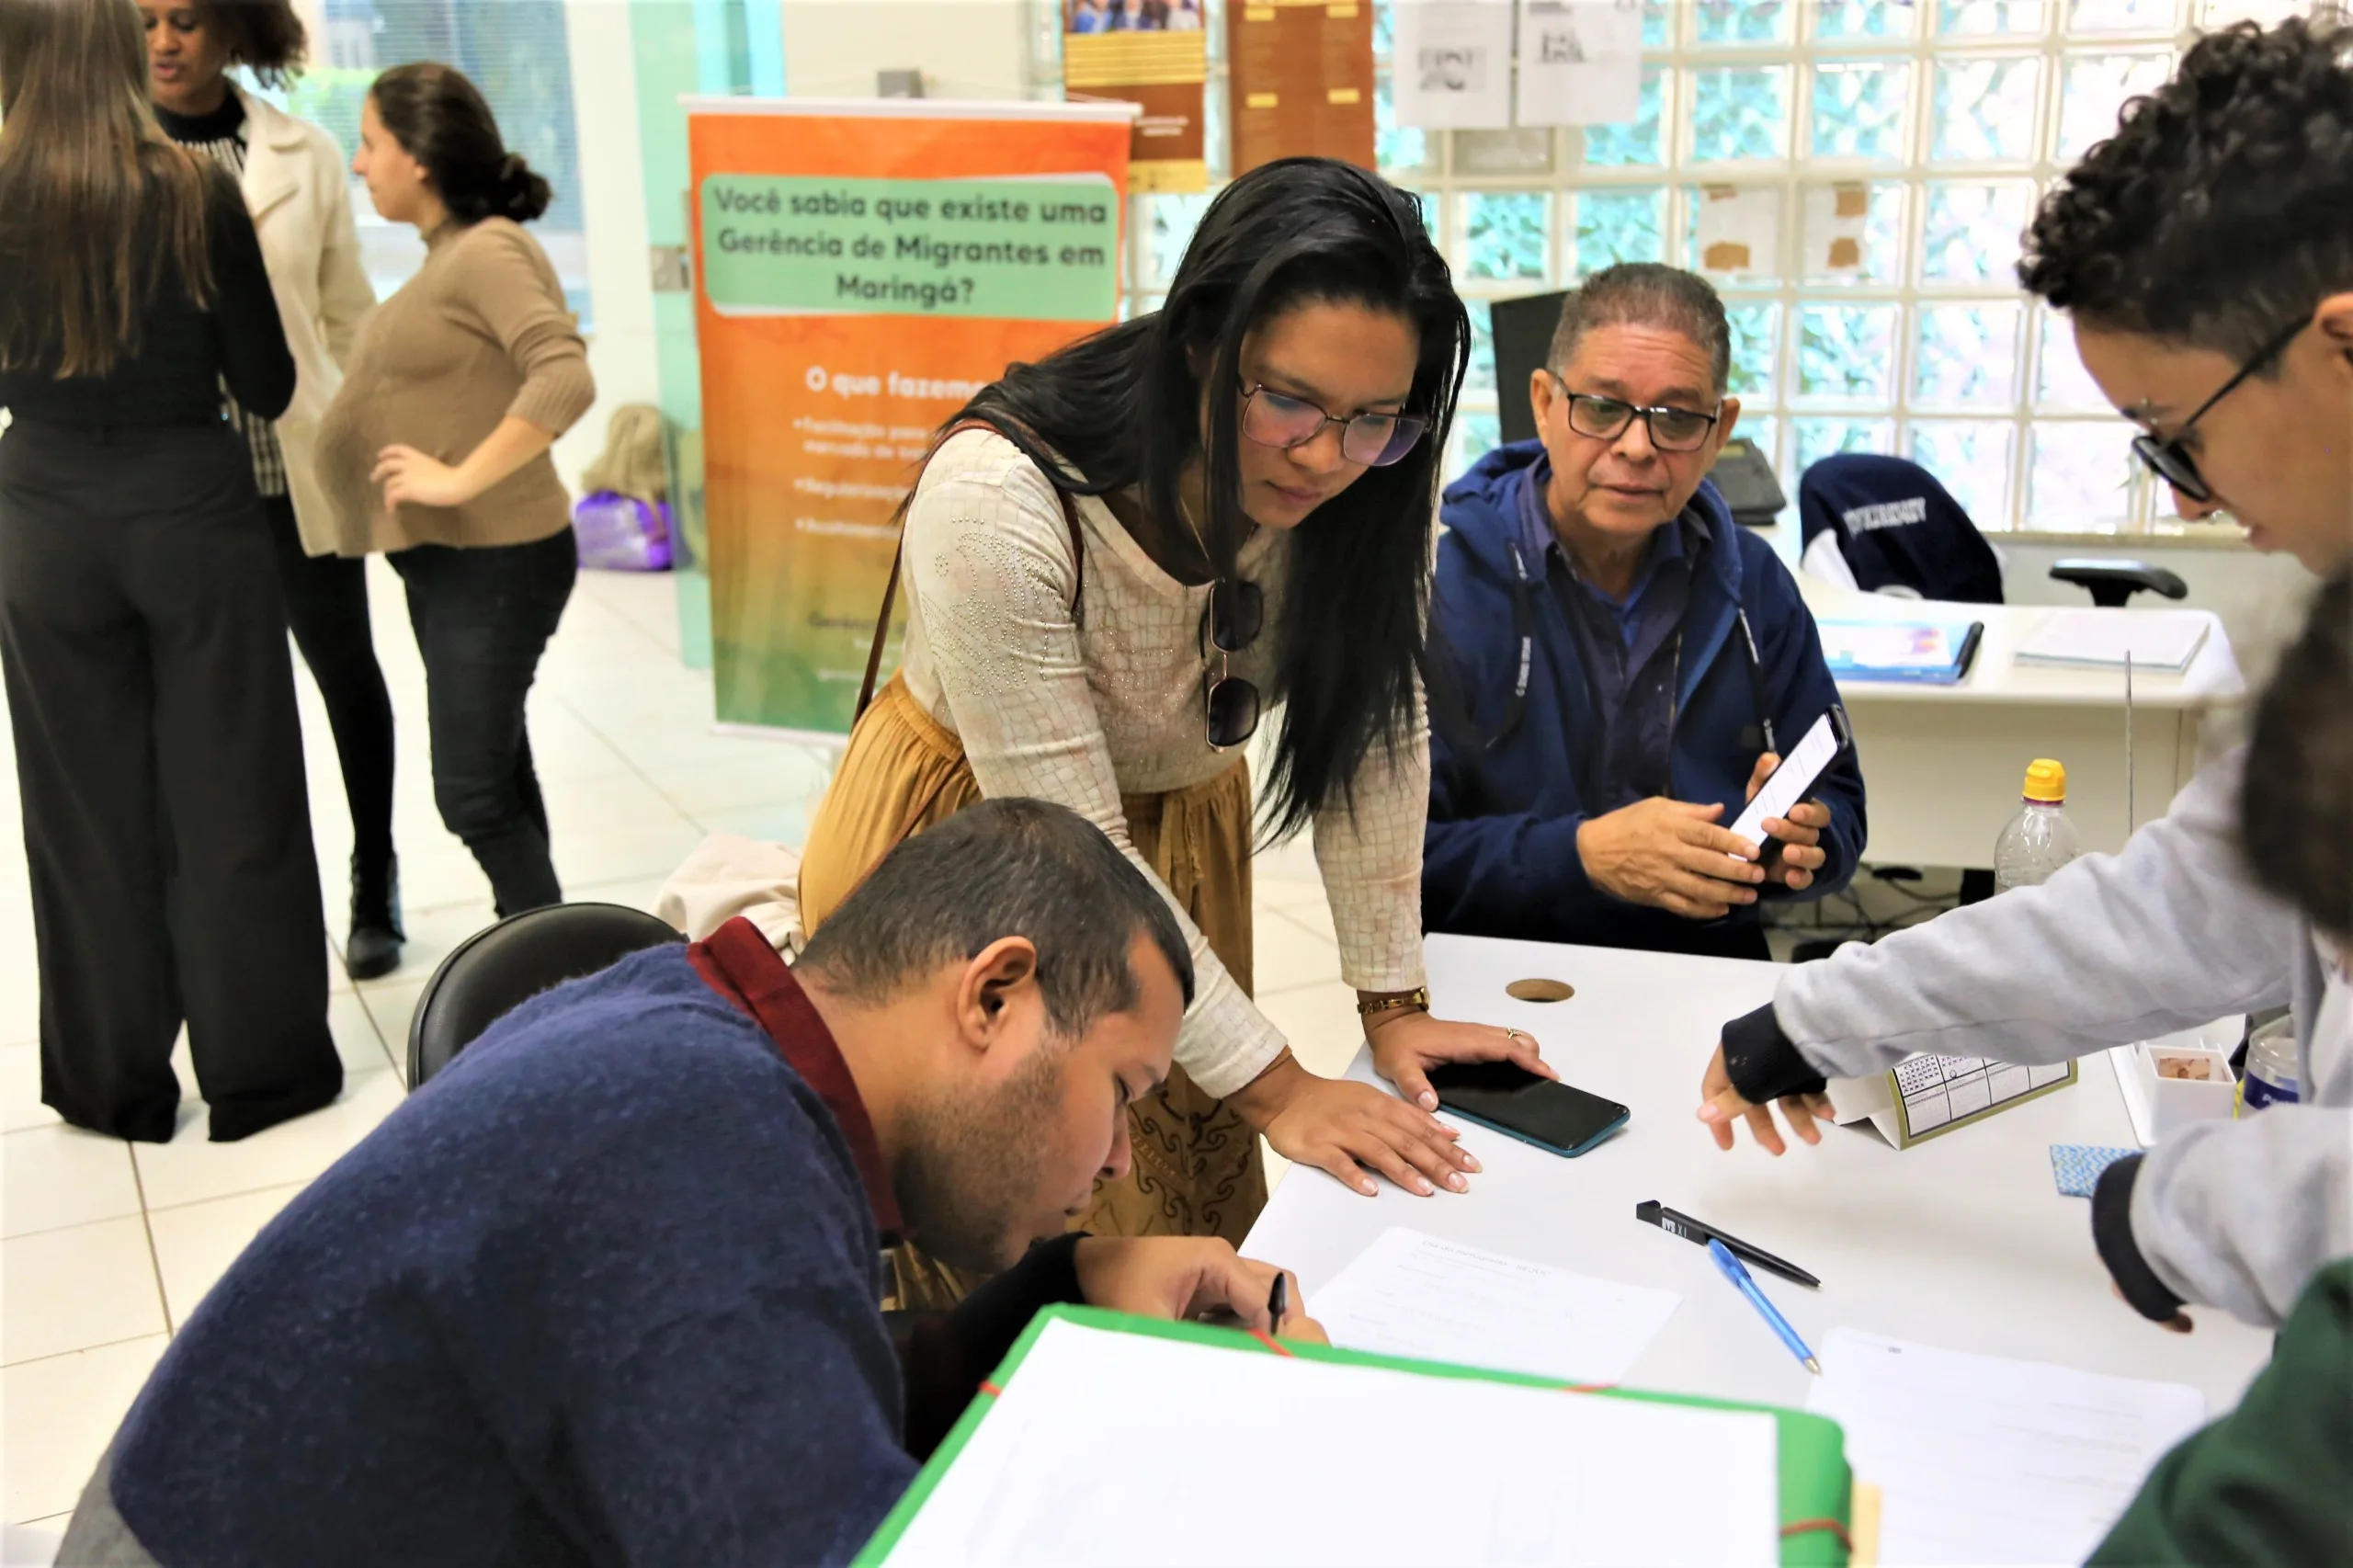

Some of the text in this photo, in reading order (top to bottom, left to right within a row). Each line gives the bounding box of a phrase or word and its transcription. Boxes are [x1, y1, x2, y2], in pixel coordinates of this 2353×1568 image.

[714, 186, 1108, 224] Você sabia que existe uma
[718, 227, 1106, 268] Gerência de Migrantes em
[835, 275, 976, 310] Maringá?
[805, 364, 827, 392] O
[832, 372, 881, 400] que
